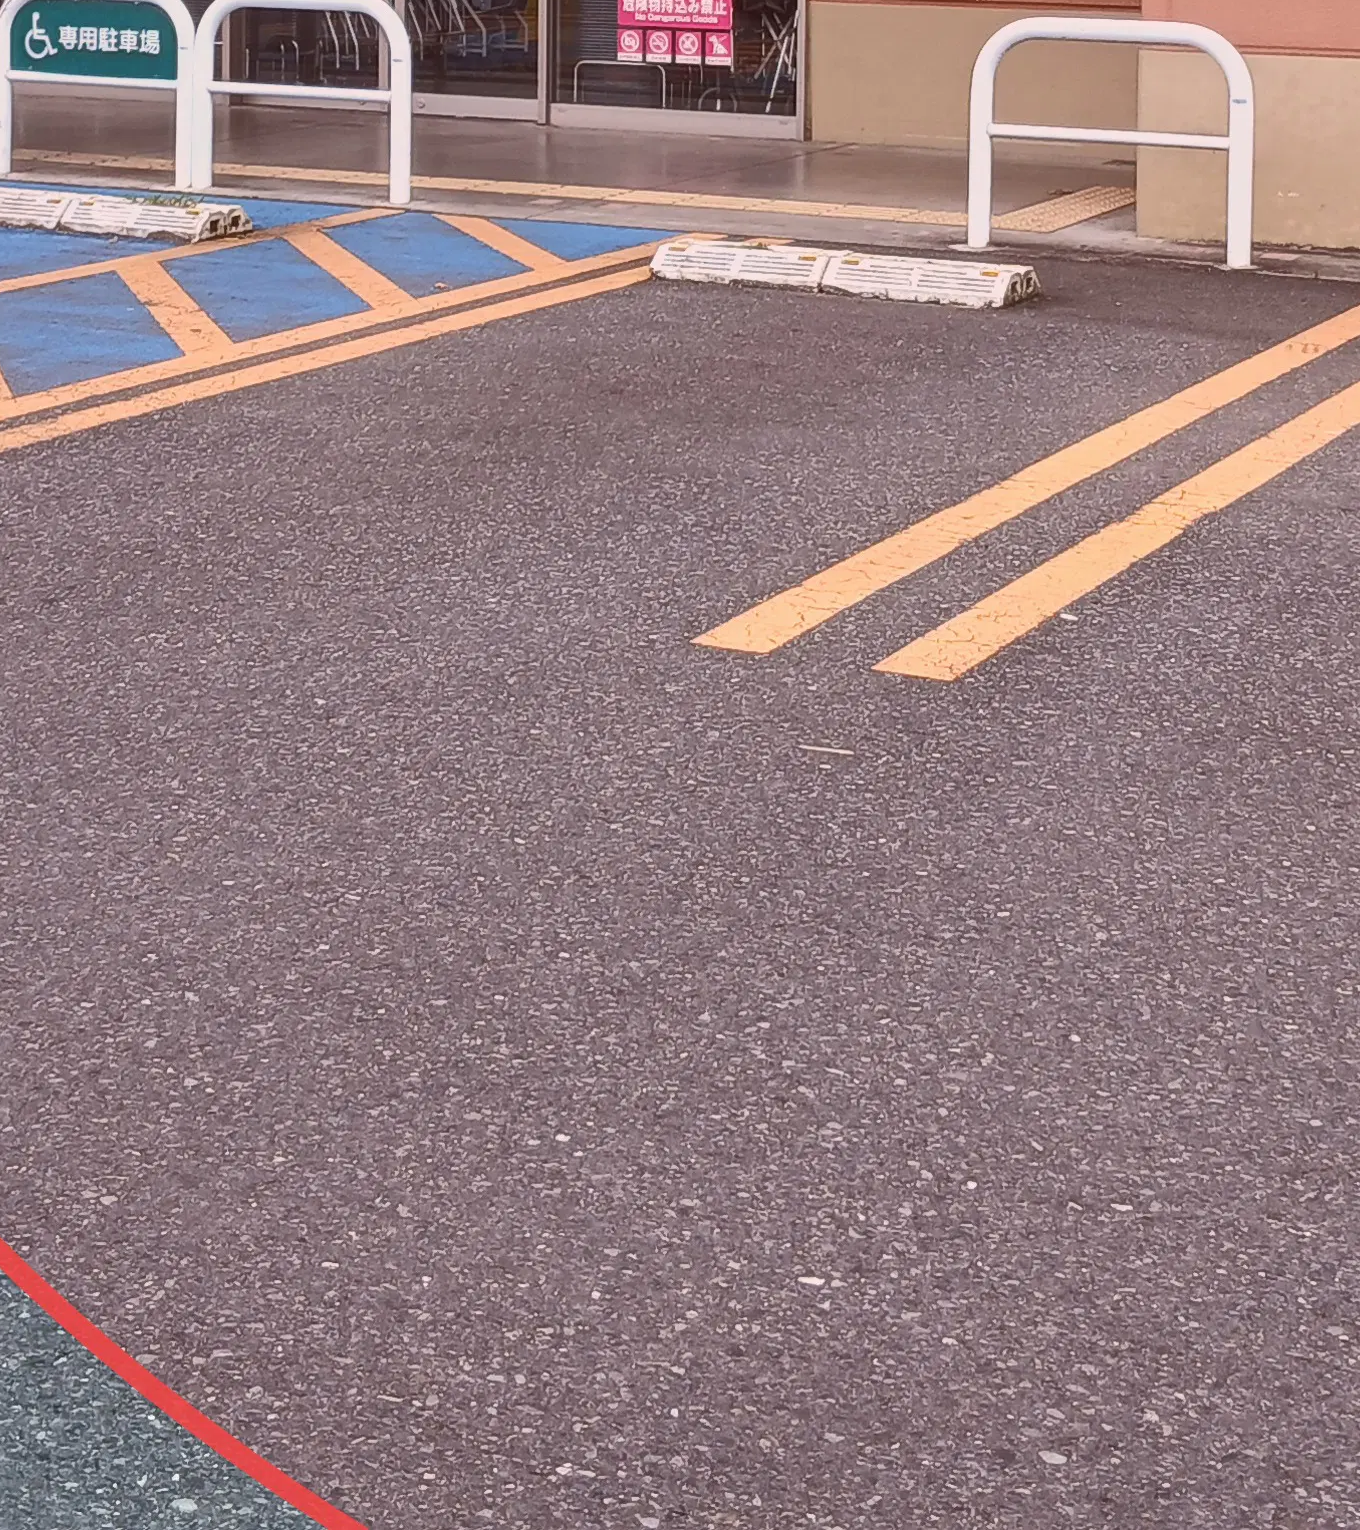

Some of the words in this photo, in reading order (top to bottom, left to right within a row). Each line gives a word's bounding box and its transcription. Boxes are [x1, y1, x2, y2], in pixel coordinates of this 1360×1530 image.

[634, 12, 647, 21] No
[648, 13, 691, 23] Dangerous
[58, 25, 161, 55] 専用駐車場
